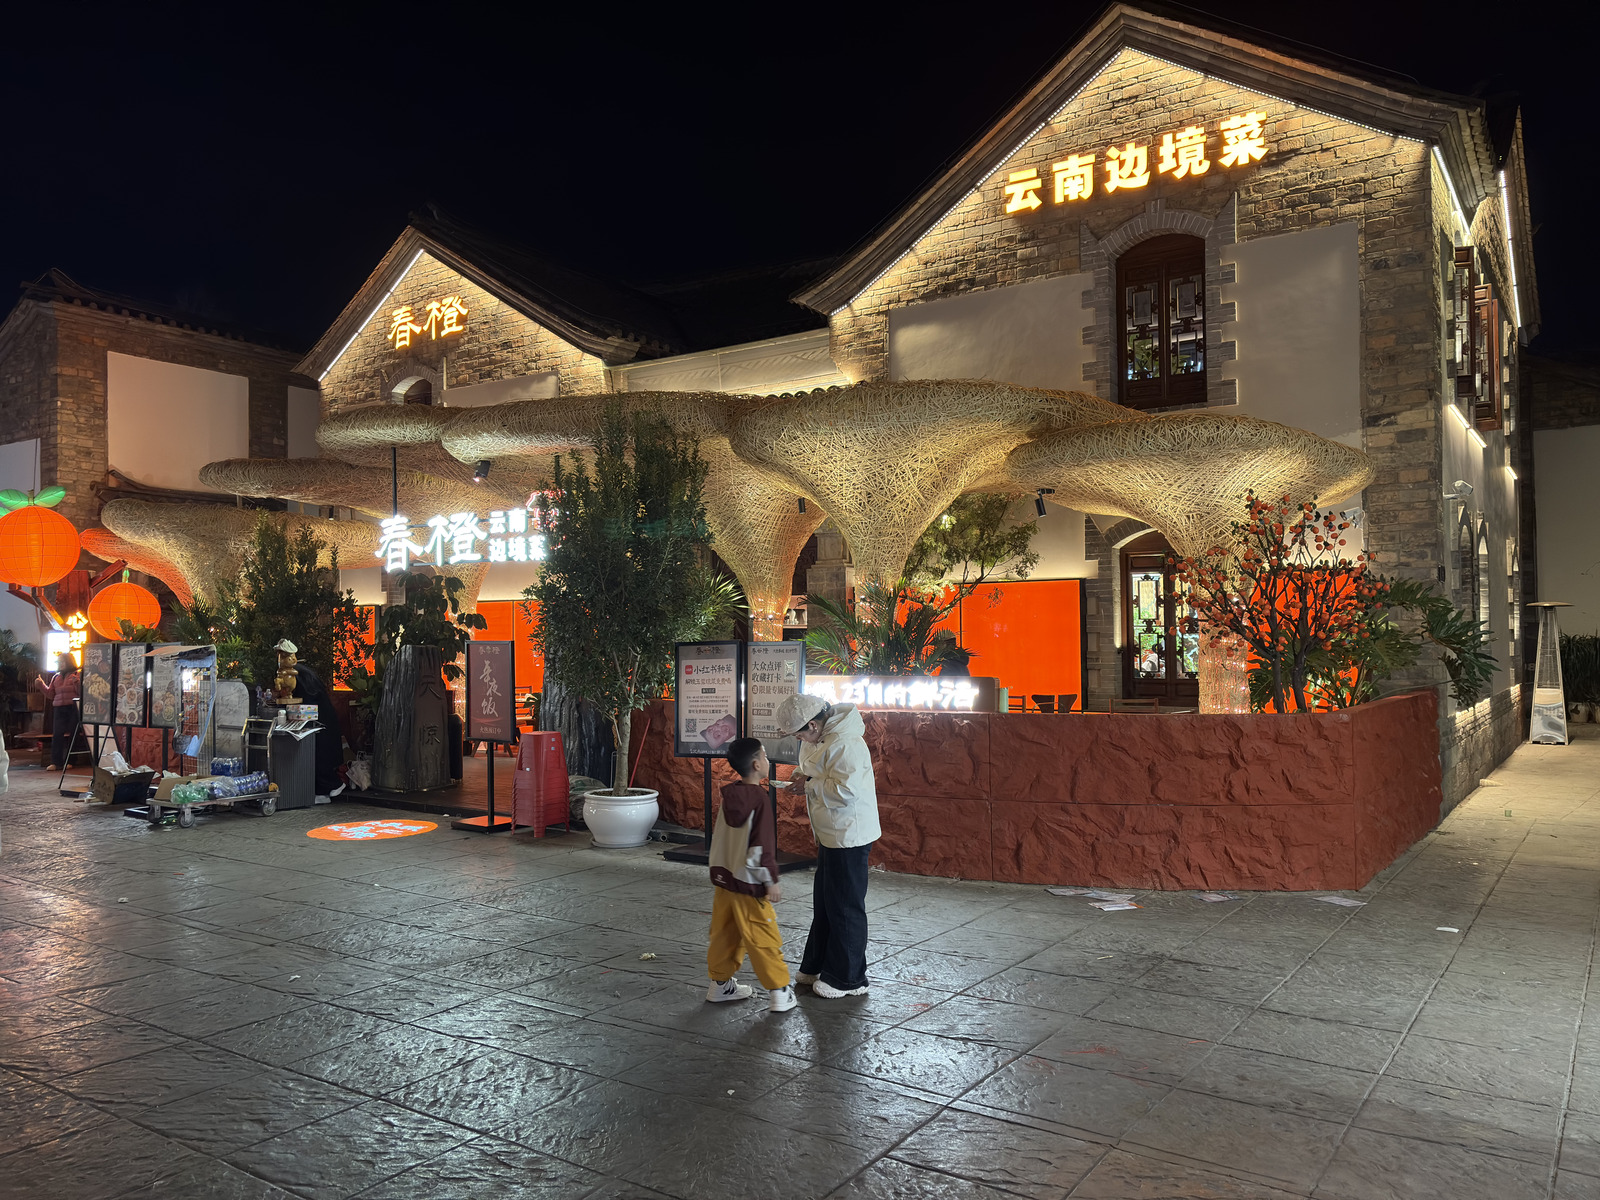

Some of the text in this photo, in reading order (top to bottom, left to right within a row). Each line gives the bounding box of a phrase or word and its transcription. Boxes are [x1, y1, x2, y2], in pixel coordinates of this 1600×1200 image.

[1004, 110, 1270, 214] 云南边境菜
[386, 295, 469, 350] 春橙
[488, 508, 529, 534] 云南
[375, 512, 489, 573] 春橙
[693, 664, 733, 675] 小红书种草
[752, 661, 782, 672] 大众点评
[752, 672, 782, 683] 收藏打卡
[479, 659, 502, 718] 年夜饭
